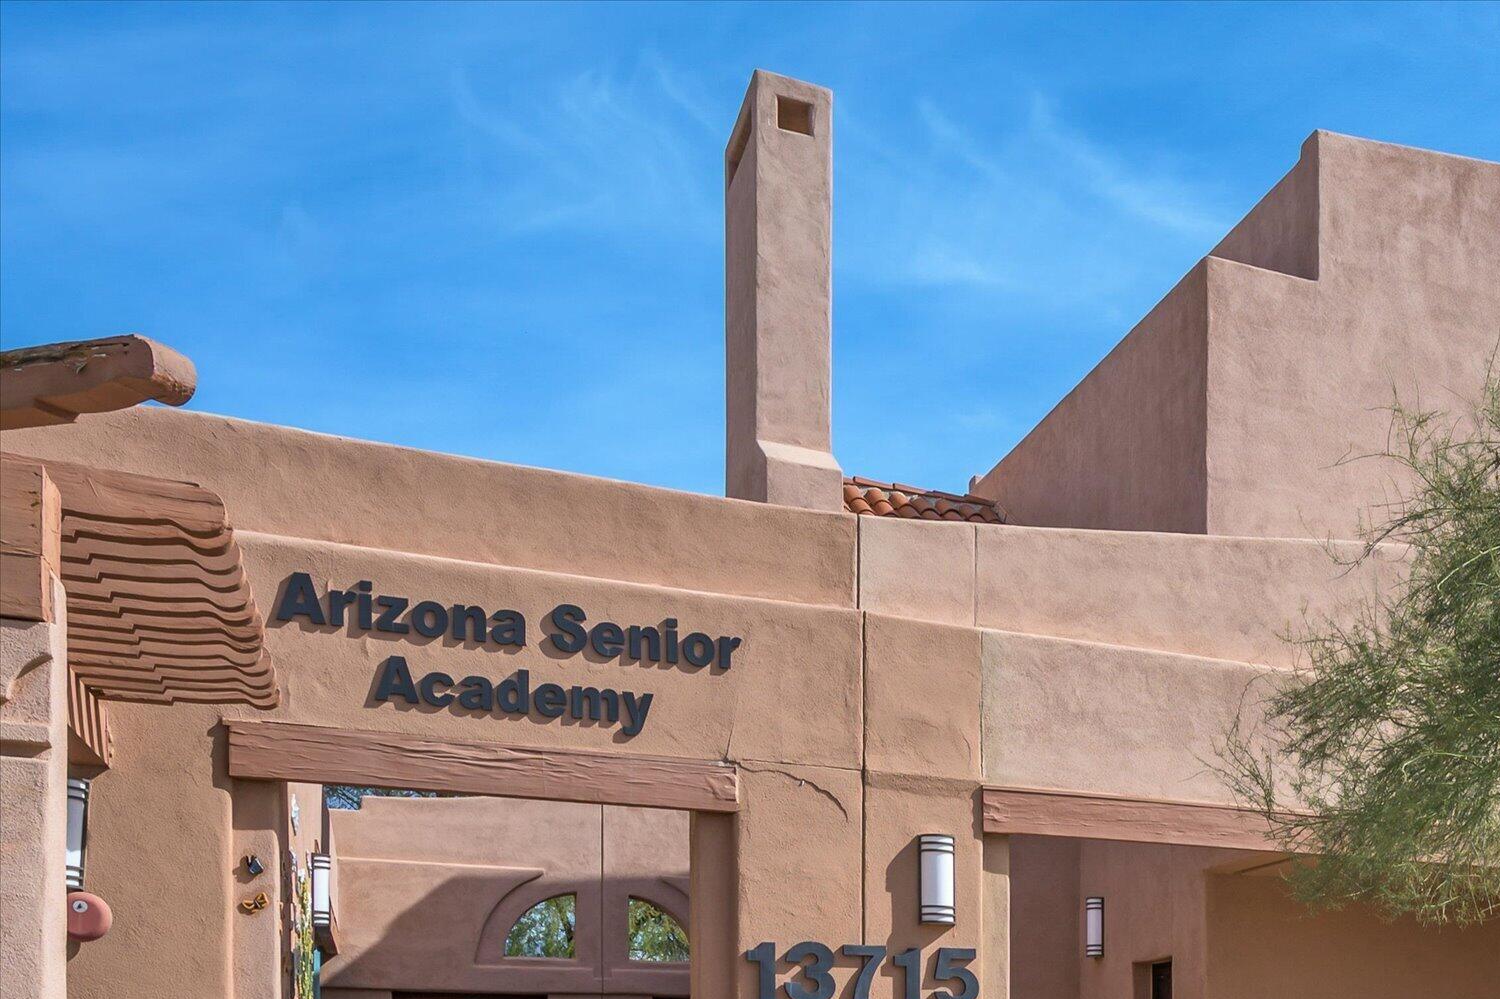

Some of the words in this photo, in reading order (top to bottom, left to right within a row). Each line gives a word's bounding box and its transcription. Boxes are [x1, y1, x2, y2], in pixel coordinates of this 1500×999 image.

[276, 571, 527, 647] Arizona
[549, 603, 741, 670] Senior
[374, 655, 653, 737] Academy
